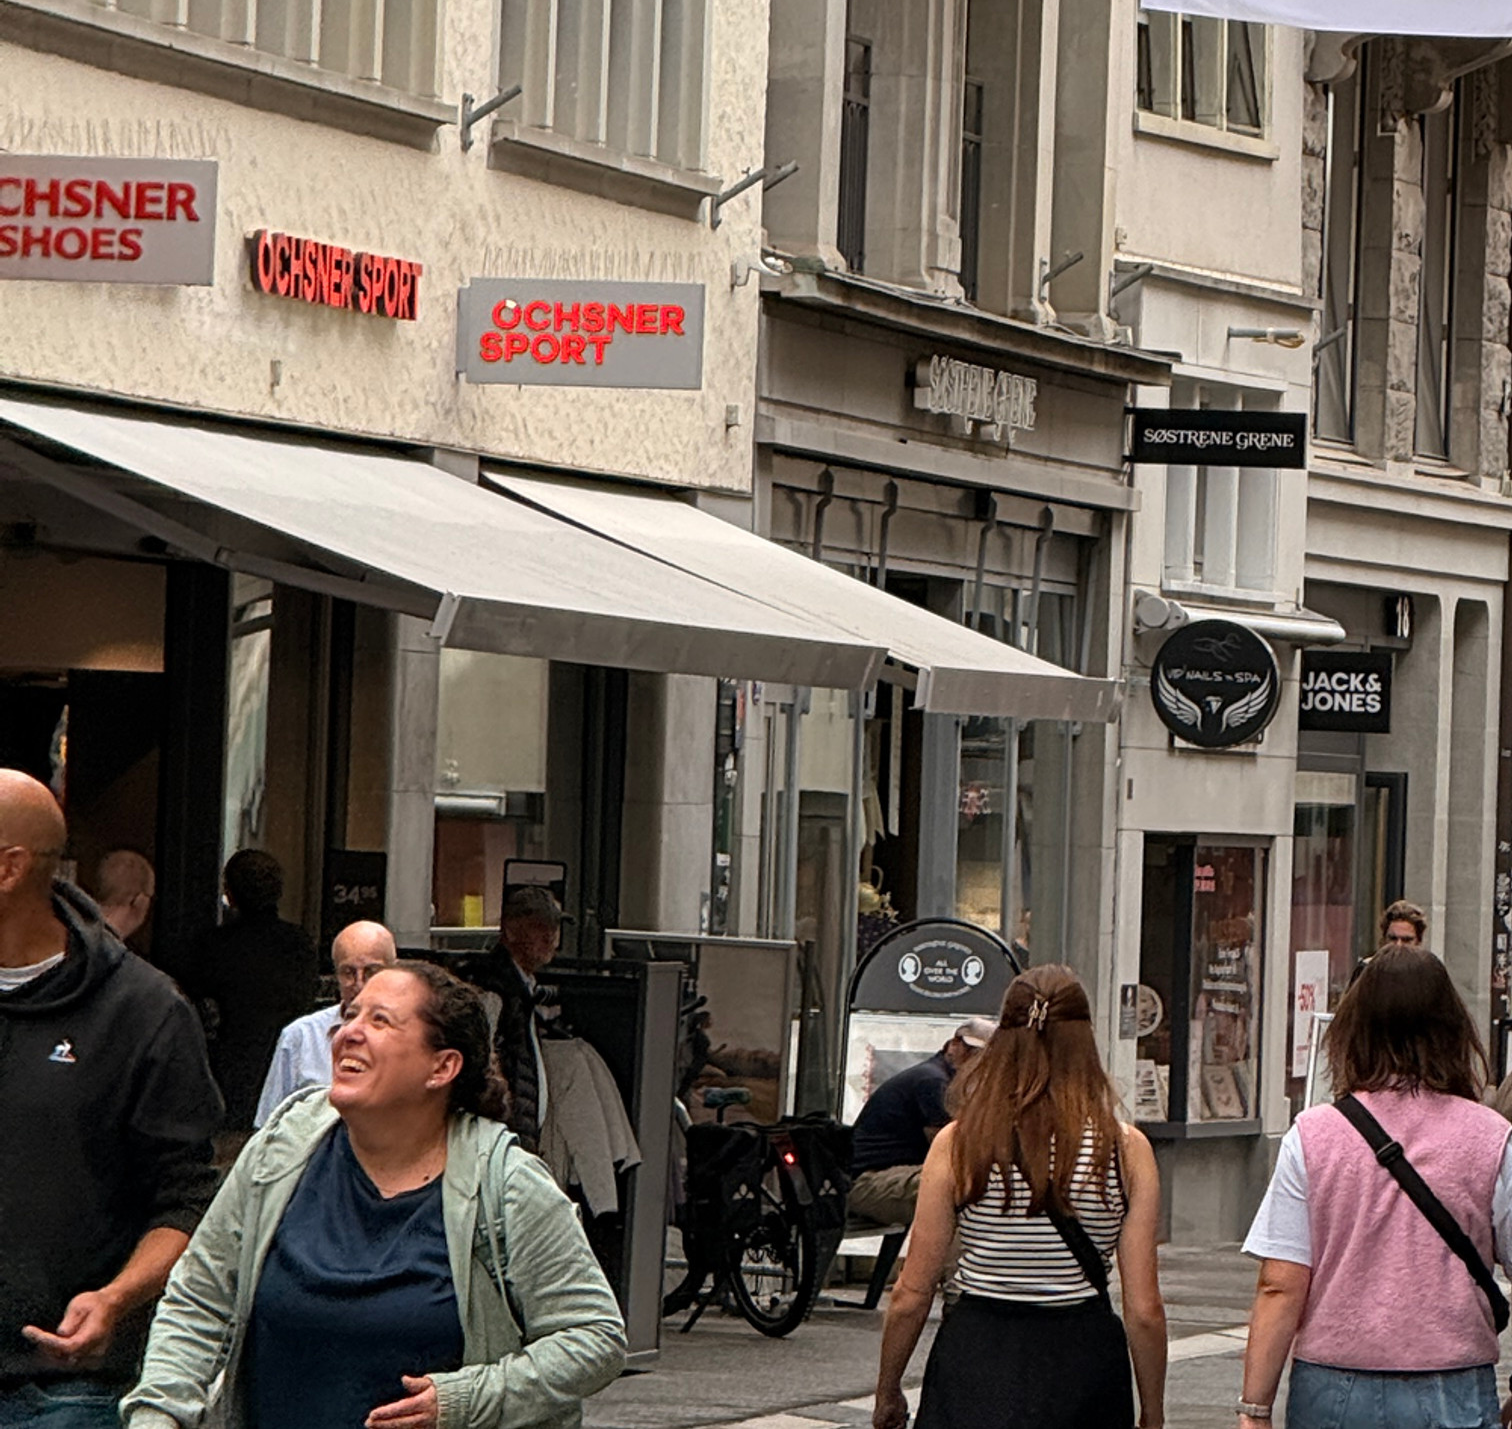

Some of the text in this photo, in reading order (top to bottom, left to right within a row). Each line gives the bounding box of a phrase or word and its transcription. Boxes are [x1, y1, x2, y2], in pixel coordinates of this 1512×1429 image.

[0, 225, 143, 261] SHOES
[257, 229, 422, 320] OCHSNER SPORT
[492, 299, 685, 336] OCHSNER
[480, 333, 611, 366] SPORT
[1143, 428, 1295, 450] SØSTRENE GRENE
[1235, 672, 1261, 683] SPA
[1302, 672, 1382, 692] JACK&
[1301, 693, 1381, 713] JONES
